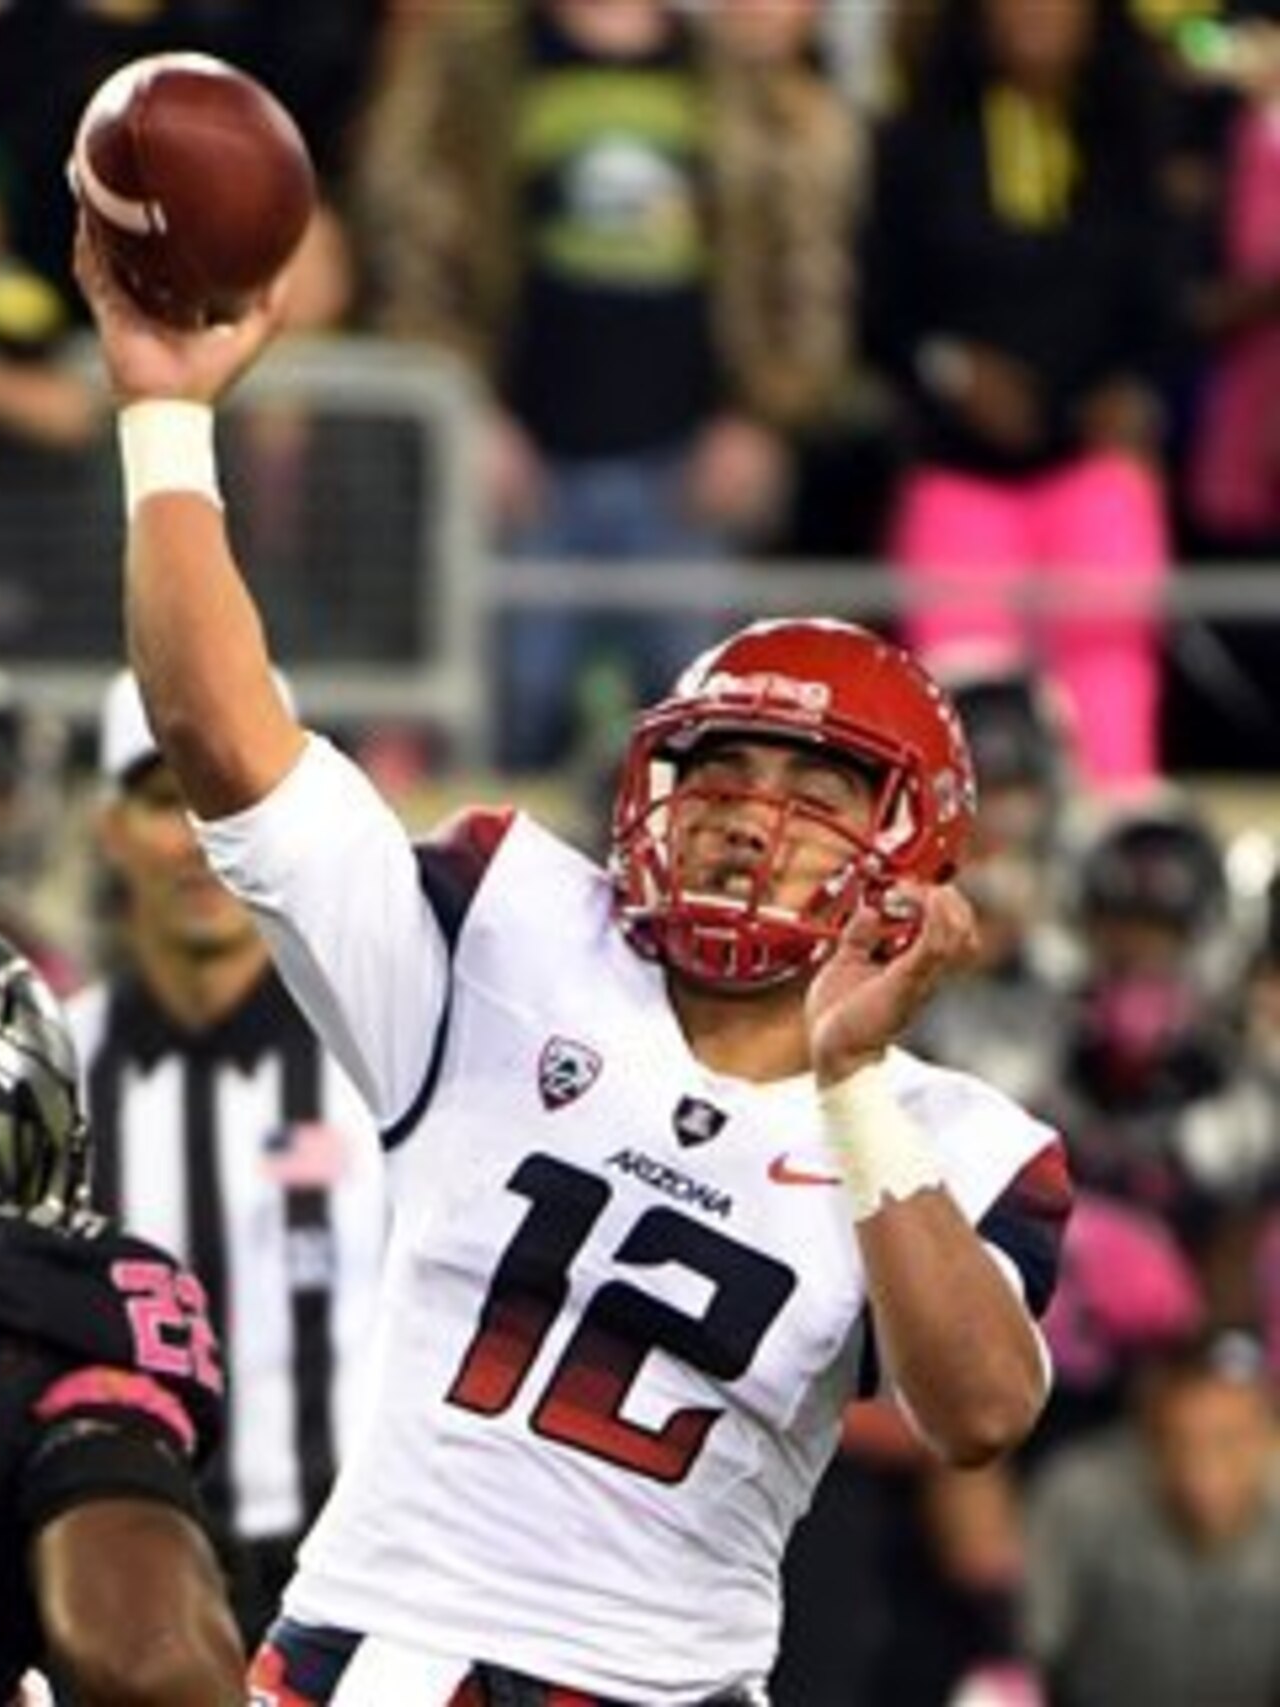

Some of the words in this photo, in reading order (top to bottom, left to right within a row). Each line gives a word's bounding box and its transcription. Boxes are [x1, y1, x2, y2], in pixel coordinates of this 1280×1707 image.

[603, 1148, 733, 1220] ARIZONA
[111, 1261, 223, 1394] 22
[445, 1152, 797, 1484] 12
